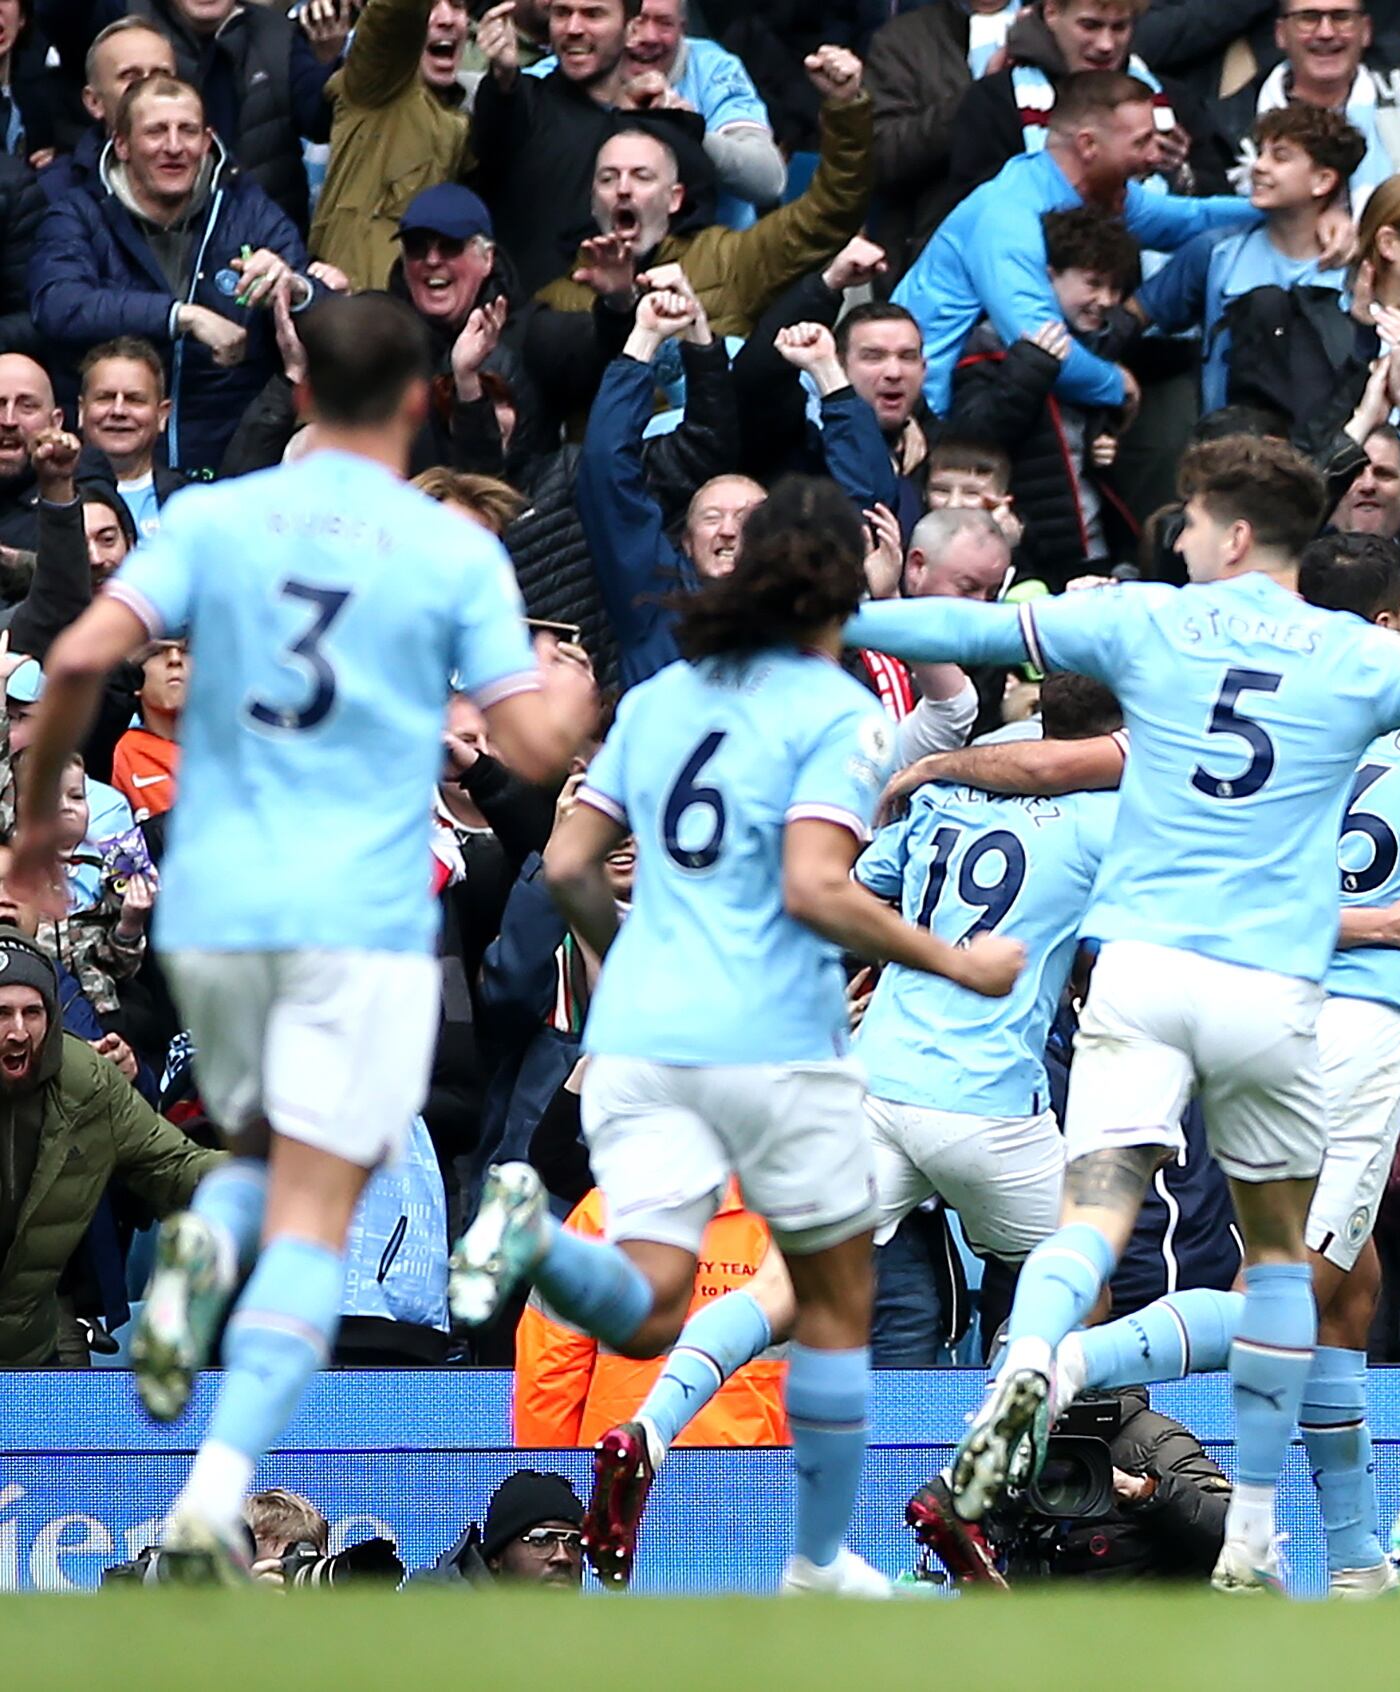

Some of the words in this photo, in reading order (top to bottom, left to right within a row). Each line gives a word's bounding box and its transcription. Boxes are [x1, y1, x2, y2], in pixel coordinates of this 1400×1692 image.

[251, 580, 352, 731] 3
[1184, 608, 1322, 656] STONES
[1191, 667, 1283, 799] 5
[664, 731, 729, 870] 6
[917, 827, 1026, 950] 19
[701, 1285, 718, 1297] to
